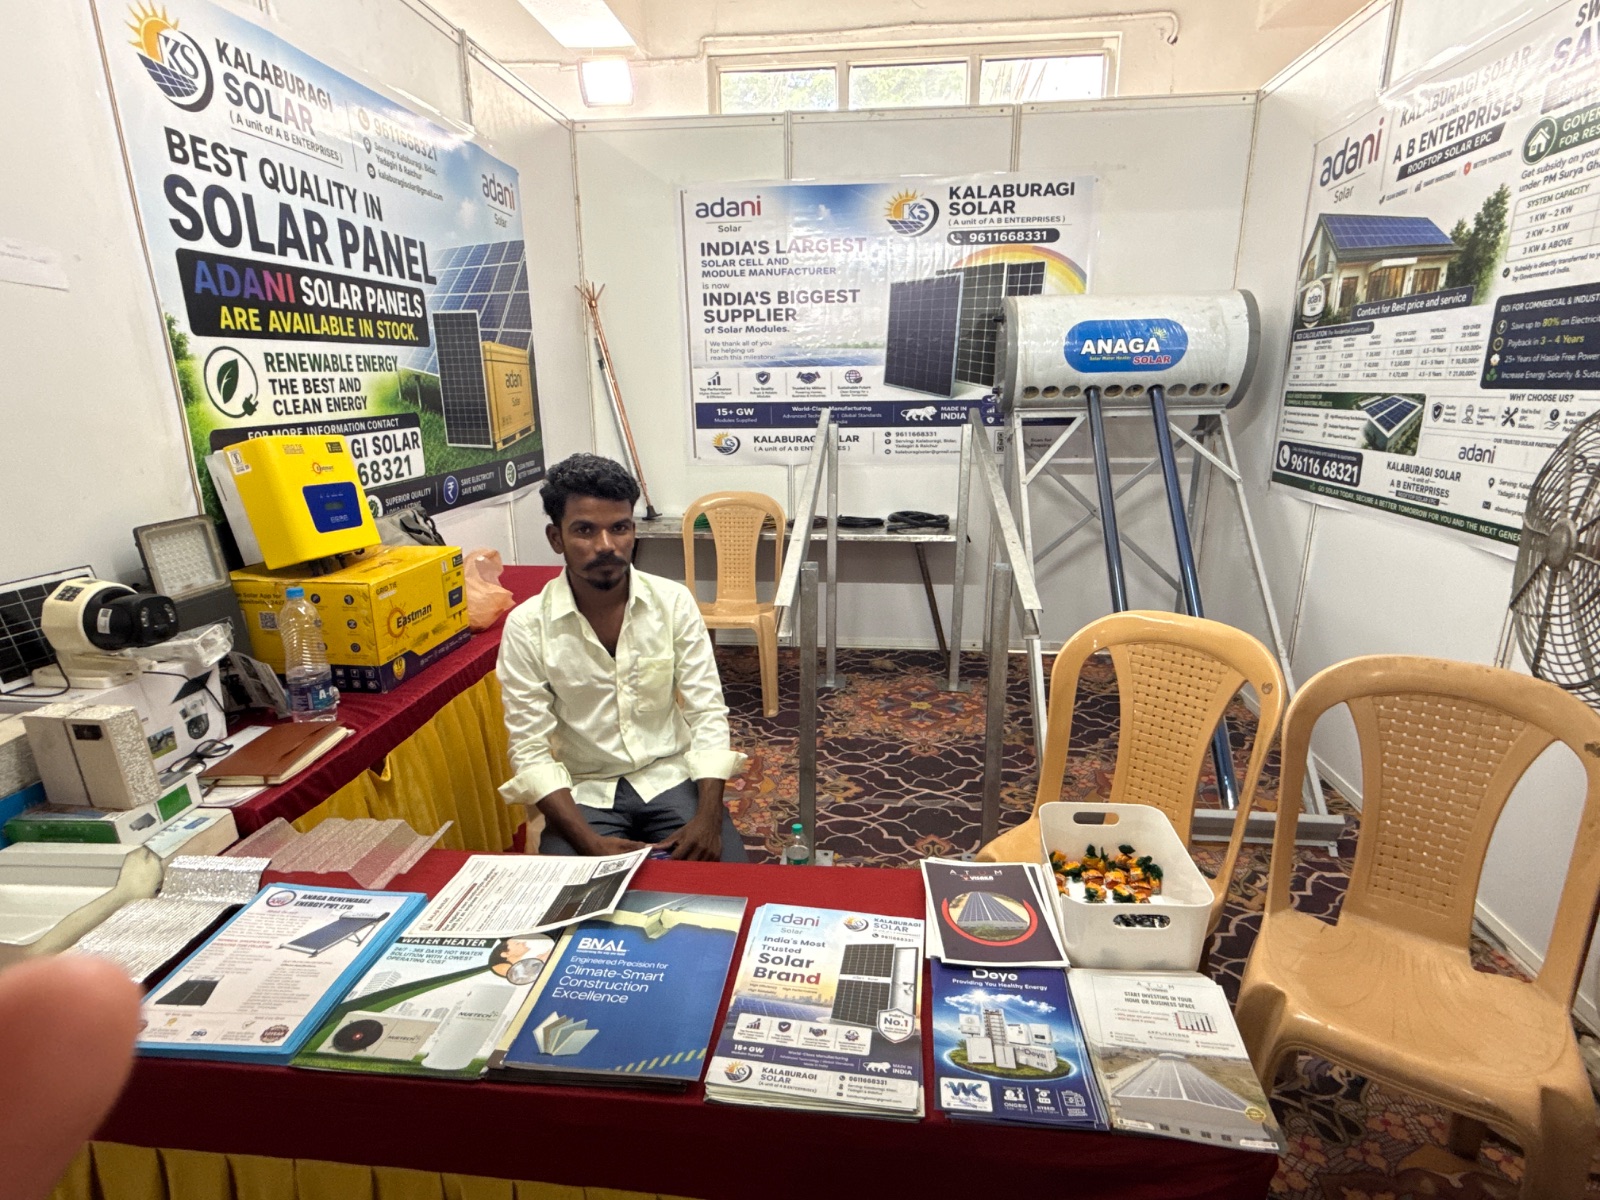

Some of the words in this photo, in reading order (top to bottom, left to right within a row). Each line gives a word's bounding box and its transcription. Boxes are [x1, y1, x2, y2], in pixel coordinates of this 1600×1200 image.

[215, 37, 333, 113] KALABURAGI
[1400, 72, 1479, 127] KALABURAGI
[1484, 46, 1532, 83] SOLAR
[223, 72, 316, 137] SOLAR
[1393, 144, 1402, 164] A
[1406, 138, 1415, 159] B
[1419, 92, 1523, 153] ENTERPRISES
[1320, 117, 1385, 187] adani
[1407, 154, 1443, 174] ROOFTOP
[1444, 140, 1472, 159] SOLAR
[1474, 132, 1493, 147] EPC
[164, 127, 247, 182] BEST
[259, 157, 357, 213] QUALITY
[363, 191, 383, 221] IN
[481, 173, 515, 211] adani
[949, 182, 1075, 200] KALABURAGI
[1334, 185, 1355, 204] Solar
[1527, 195, 1553, 208] SYSTEM
[1555, 184, 1591, 200] CAPACITY
[695, 195, 761, 218] adani
[949, 200, 1016, 216] SOLAR
[163, 174, 333, 265] SOLAR
[337, 218, 437, 285] PANEL
[718, 224, 742, 233] Solar
[969, 231, 1047, 242] 9611668331
[700, 240, 770, 257] INDIA'S
[776, 237, 867, 255] LARGEST
[701, 259, 736, 268] SOLAR
[738, 258, 764, 267] CELL
[766, 257, 789, 266] AND
[701, 269, 746, 278] MODULE
[749, 267, 837, 277] MANUFACTURER
[194, 260, 296, 304] ADANI
[300, 276, 363, 311] SOLAR
[365, 290, 423, 318] PANELS
[703, 291, 771, 306] INDIA'S
[777, 289, 861, 305] BIGGEST
[1357, 308, 1380, 317] Contact
[1392, 302, 1405, 312] Best
[1407, 300, 1424, 312] price
[1426, 298, 1438, 307] and
[1441, 294, 1467, 305] service
[220, 306, 262, 332] ARE
[268, 310, 355, 337] AVAILABLE
[358, 319, 373, 338] IN
[377, 321, 419, 341] STOCK.
[704, 308, 797, 323] SUPPLIER
[704, 326, 716, 334] of
[717, 326, 743, 334] Solar
[745, 325, 790, 333] Modules.
[1081, 337, 1160, 355] ANAGA
[1508, 339, 1532, 348] Payback
[1541, 336, 1546, 345] 3
[1563, 335, 1584, 343] Years
[264, 352, 354, 373] RENEWABLE
[357, 355, 398, 372] ENERGY
[1133, 355, 1171, 365] SOLAR
[269, 378, 298, 394] THE
[302, 378, 335, 394] BEST
[339, 378, 361, 393] AND
[505, 370, 522, 388] adani
[273, 398, 324, 416] CLEAN
[327, 396, 368, 412] ENERGY
[1528, 394, 1557, 402] CHOOSE
[1559, 394, 1574, 402] US?
[717, 408, 733, 416] 15+
[736, 408, 754, 416] GW
[941, 412, 966, 420] INDIA
[272, 428, 303, 436] MORE
[307, 421, 366, 435] INFORMATION
[367, 418, 399, 430] CONTACT
[373, 431, 420, 456] SOLAR
[1459, 444, 1496, 464] adani
[1290, 454, 1320, 475] 96116
[1322, 462, 1358, 483] 68321
[1387, 461, 1432, 477] KALABURAGI
[1434, 469, 1461, 482] SOLAR
[385, 493, 410, 507] SUPERIOR
[411, 487, 432, 500] QUALITY
[1396, 481, 1400, 489] B
[1403, 481, 1449, 498] ENTERPRISES
[397, 604, 432, 629] Eastman
[294, 901, 323, 909] ENERGY
[327, 896, 372, 904] RENEWABLE
[770, 913, 821, 927] adani
[873, 918, 921, 928] KALABURAGI
[873, 923, 908, 933] SOLAR
[443, 939, 486, 947] HEATER
[578, 937, 627, 952] BNAL
[762, 944, 801, 954] Trusted
[764, 936, 798, 945] India's
[800, 940, 825, 948] Most
[571, 956, 617, 966] Engineered
[618, 960, 655, 969] Precision
[758, 953, 814, 969] Solar
[565, 965, 664, 981] Climate-Smart
[753, 967, 821, 985] Brand
[559, 976, 648, 993] Construction
[952, 978, 983, 987] Providing
[998, 982, 1023, 990] Healthy
[552, 987, 628, 1004] Excellence
[1142, 993, 1169, 1001] INVESTING
[883, 1016, 909, 1028] No.1
[760, 1074, 791, 1084] SOLAR
[762, 1067, 817, 1081] KALABURAGI
